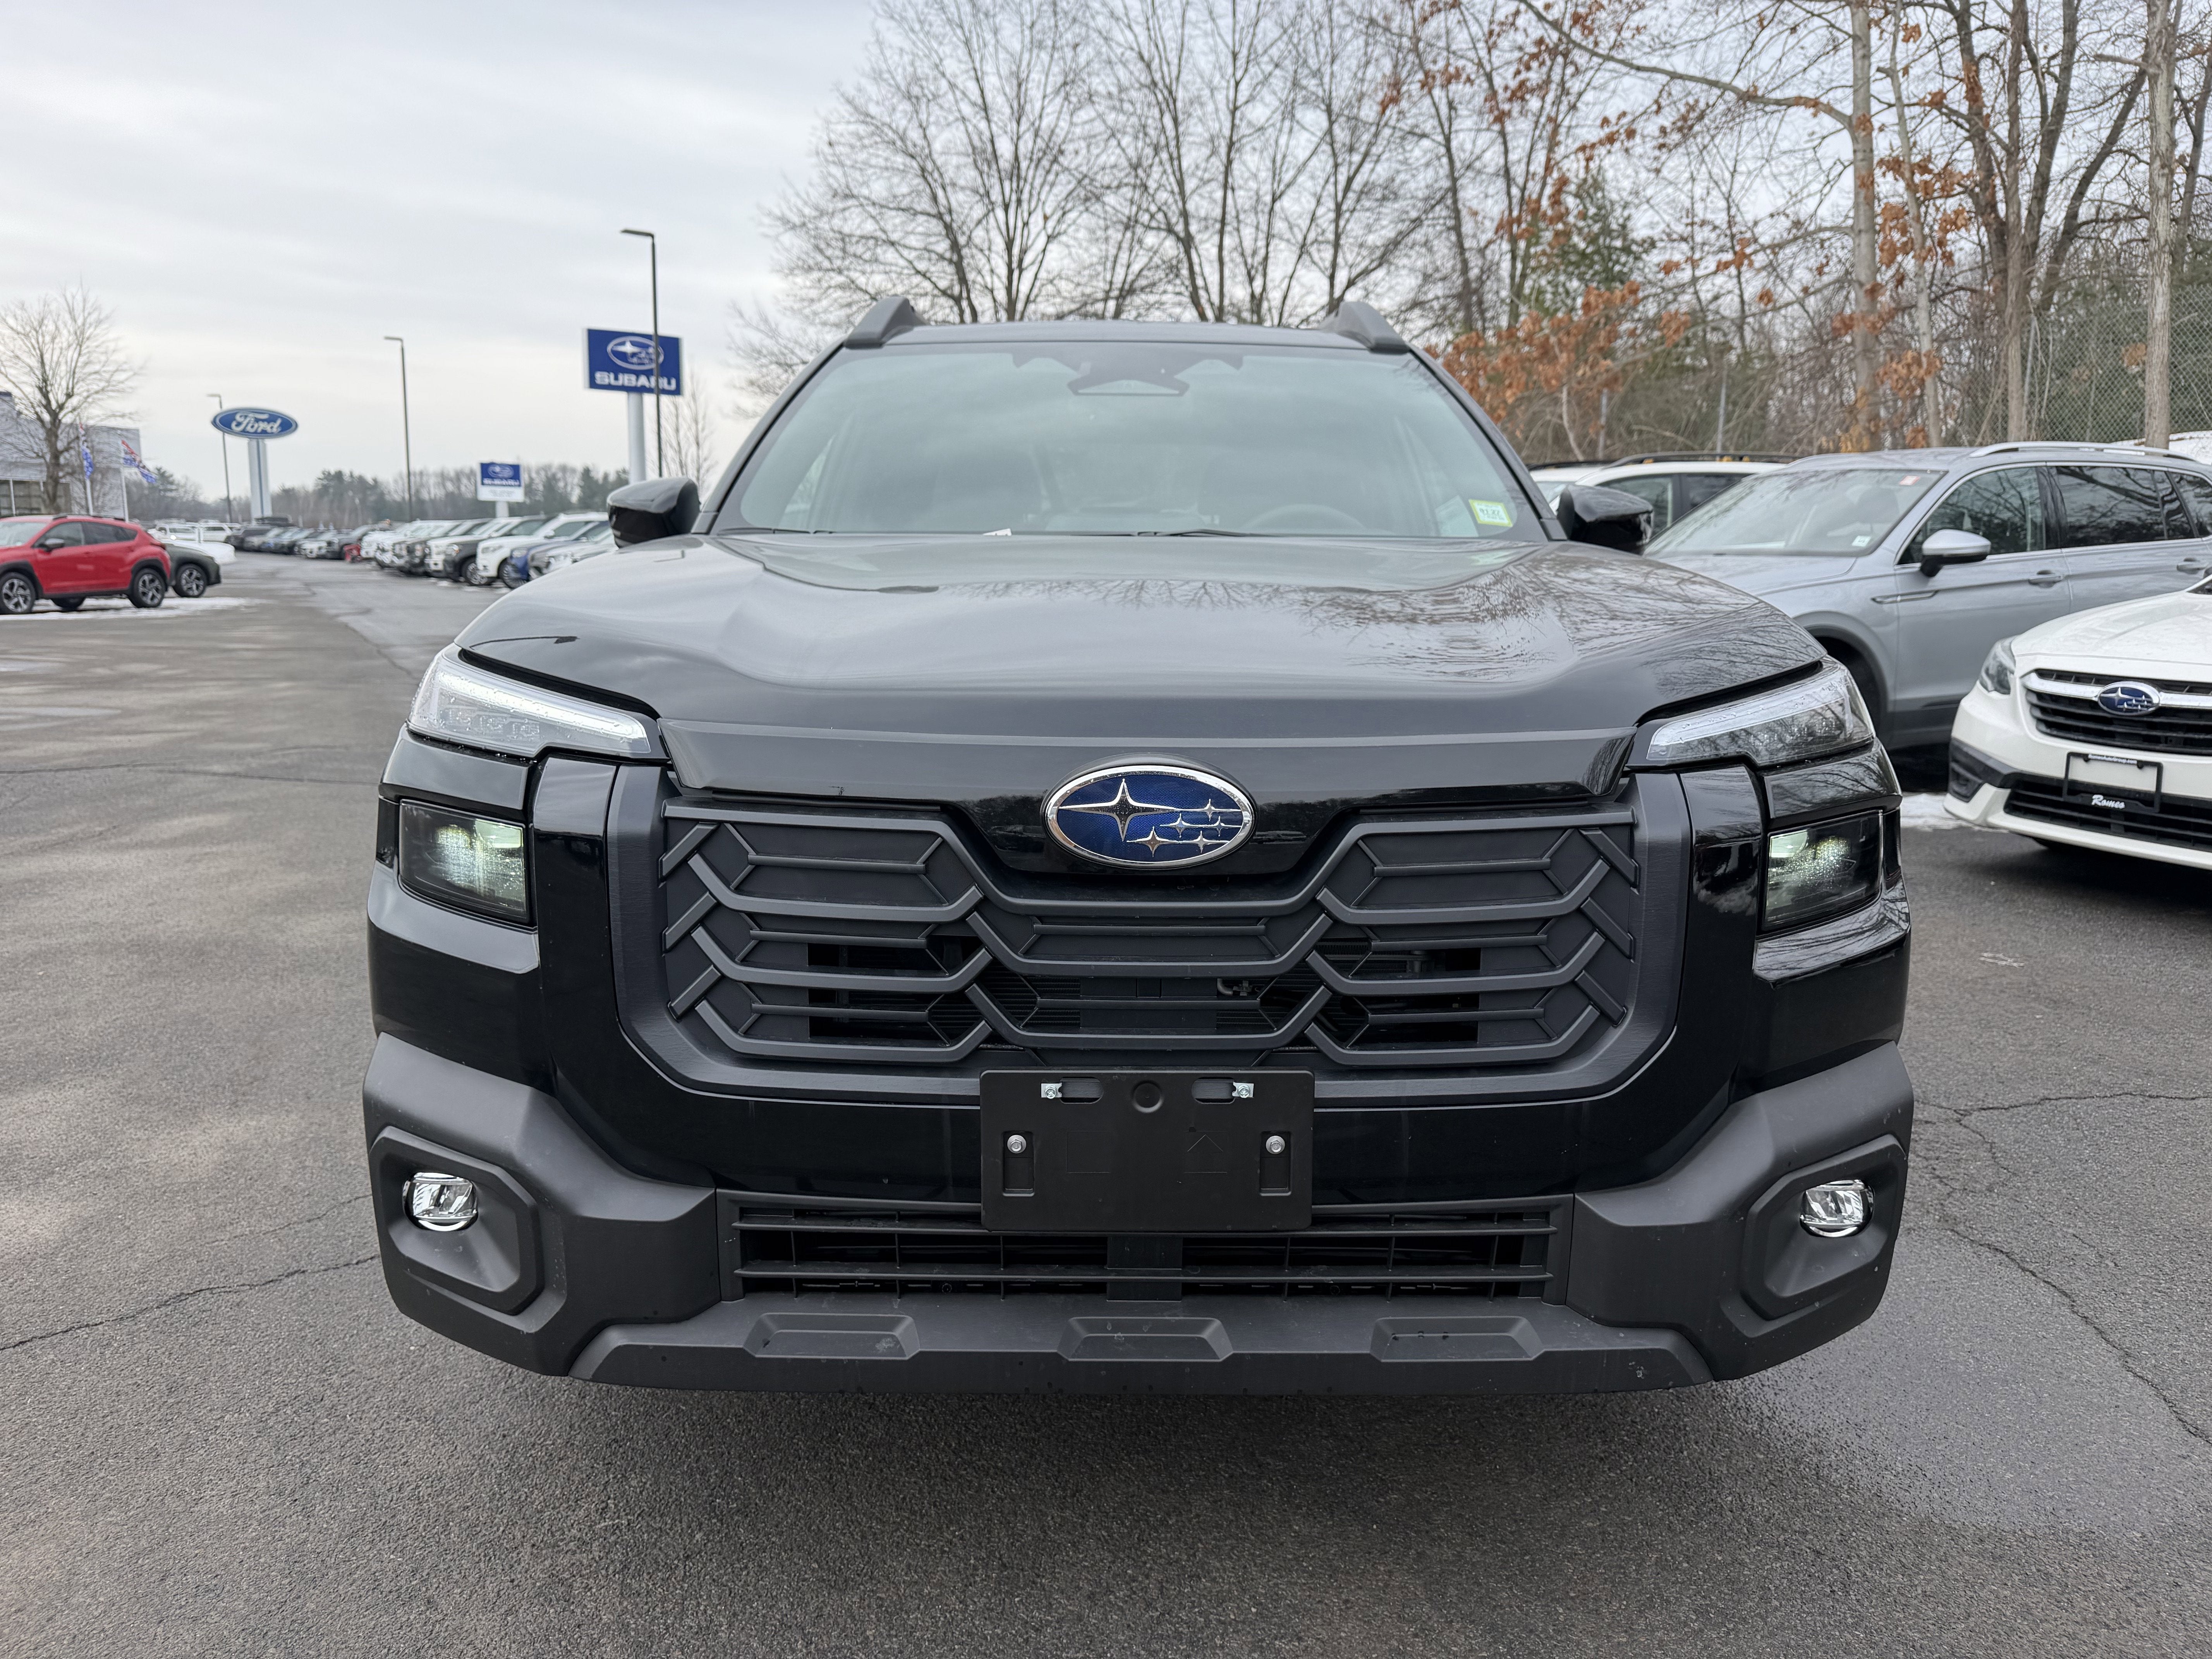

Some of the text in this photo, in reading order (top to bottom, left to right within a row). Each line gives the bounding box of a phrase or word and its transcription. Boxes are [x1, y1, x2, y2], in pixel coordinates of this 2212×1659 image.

[594, 371, 676, 391] SUBARU
[231, 411, 282, 433] Ford
[2092, 794, 2125, 809] Romeo
